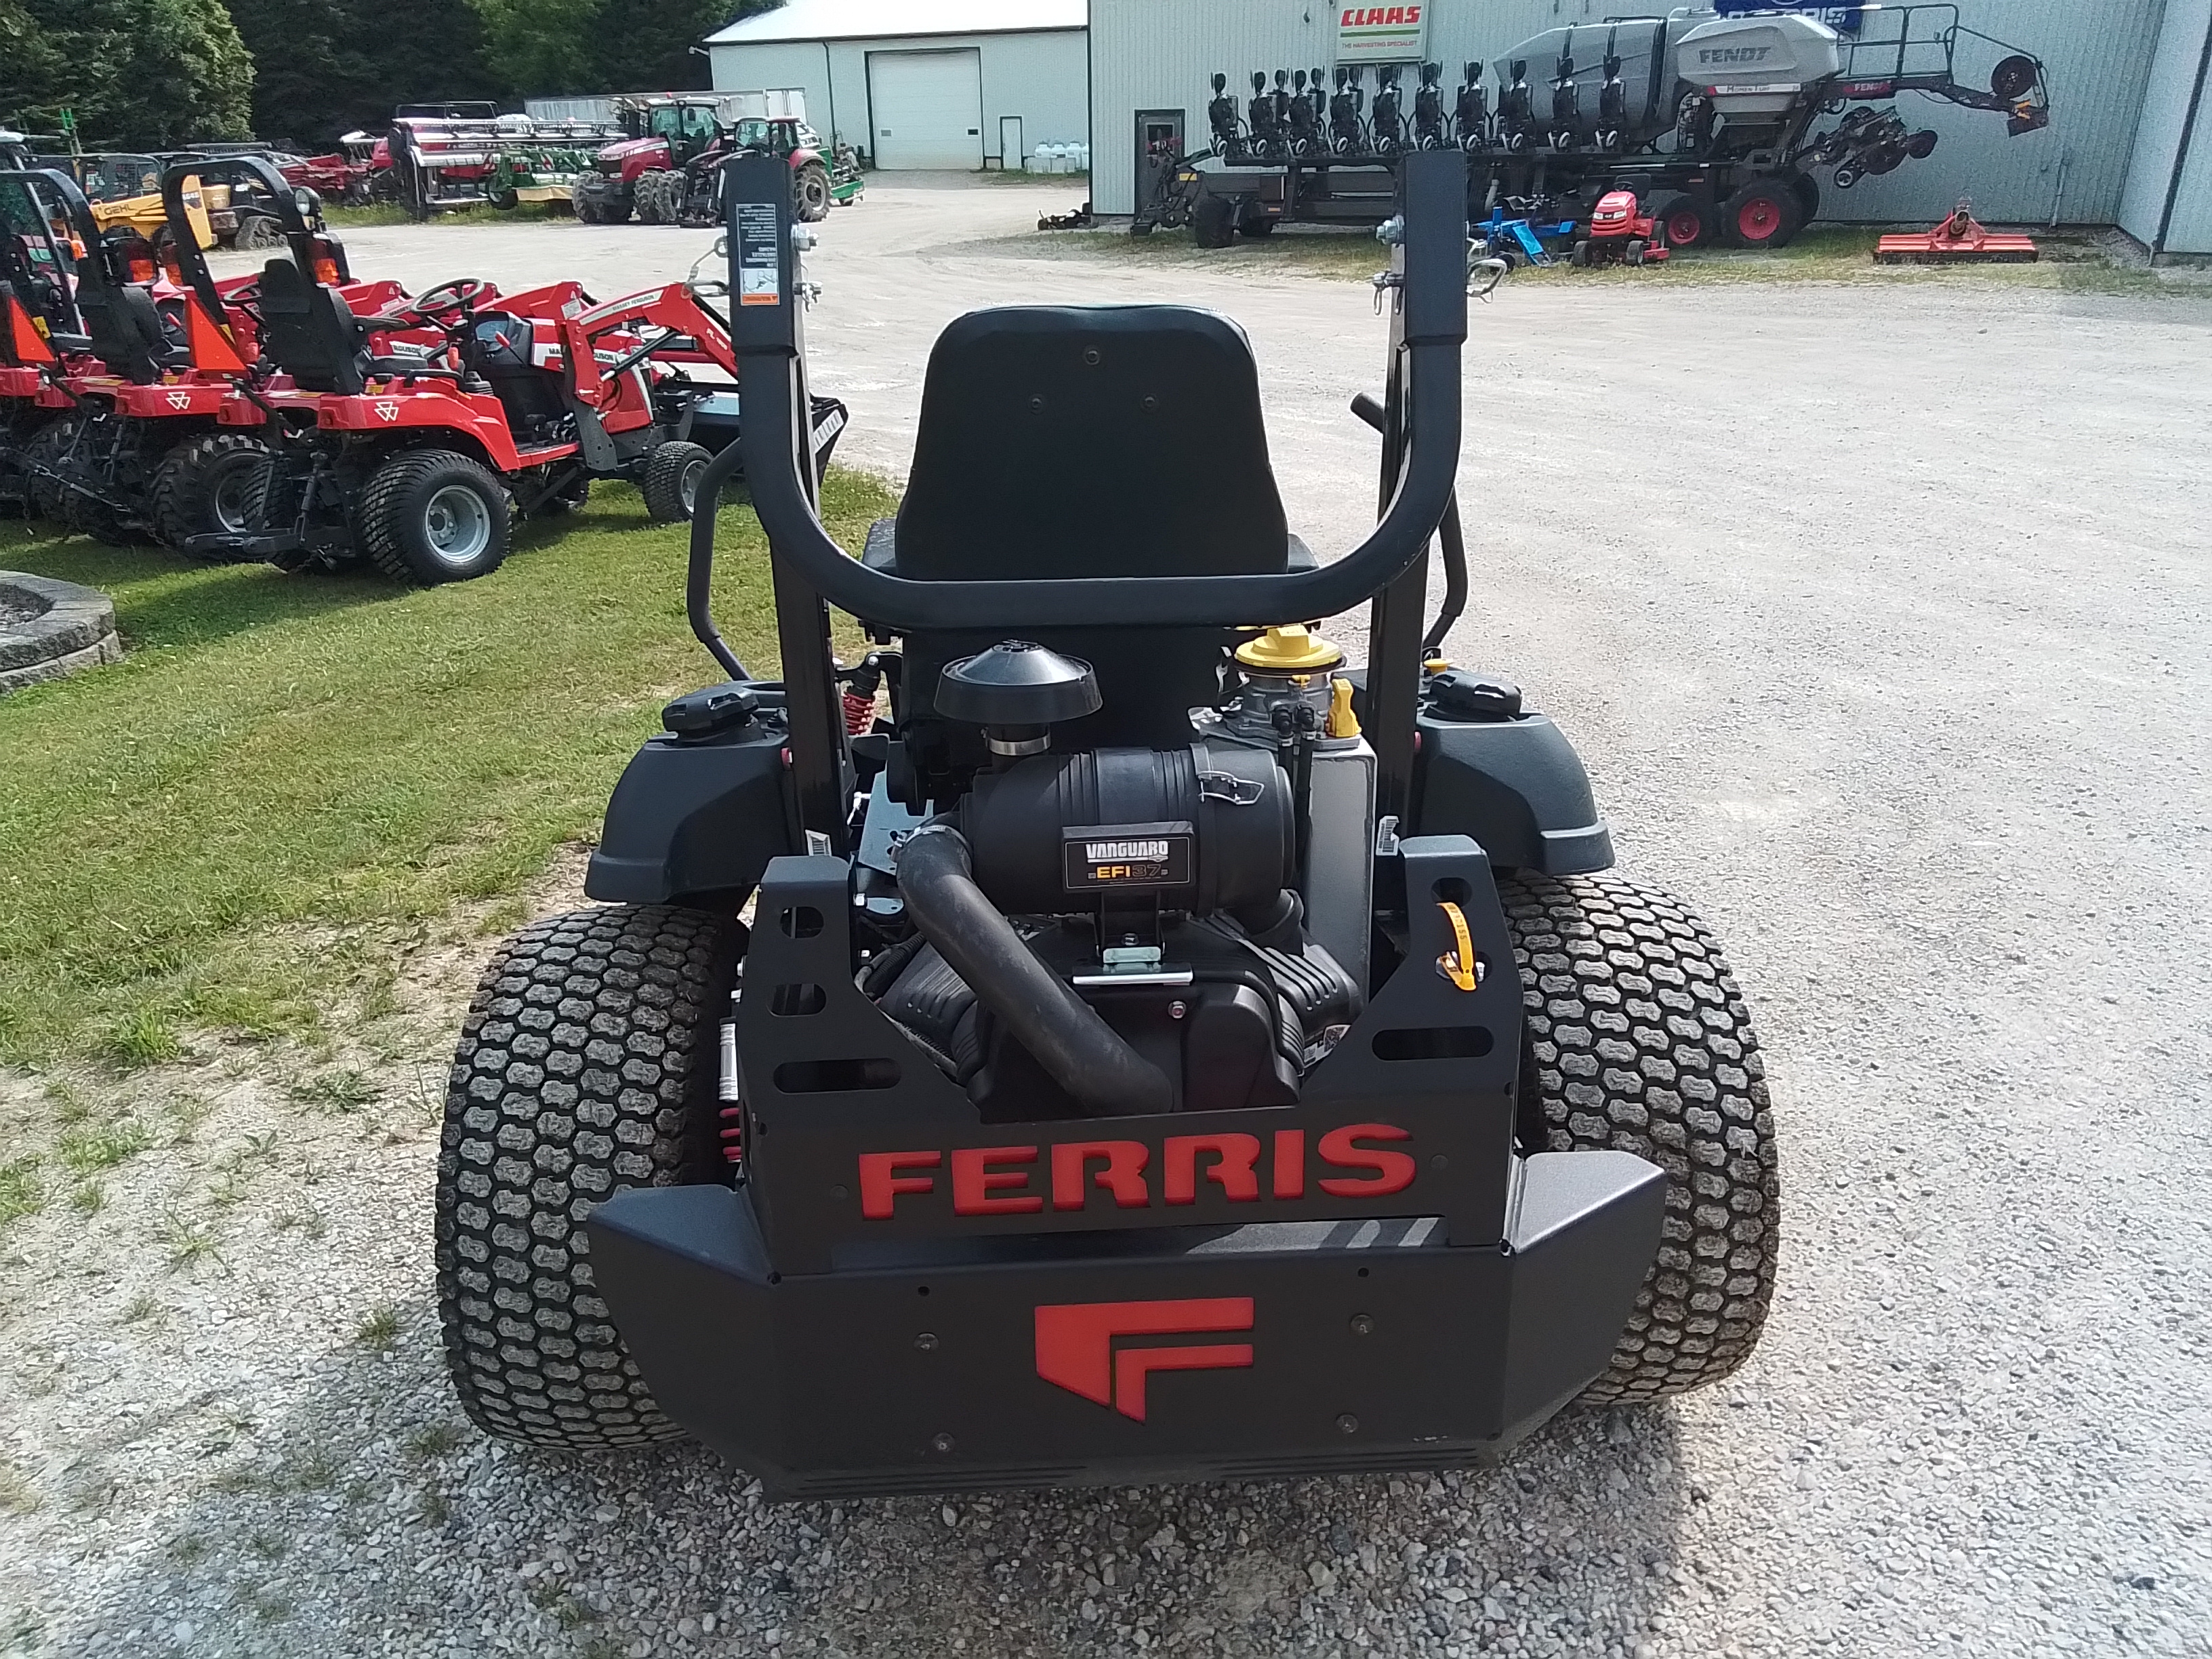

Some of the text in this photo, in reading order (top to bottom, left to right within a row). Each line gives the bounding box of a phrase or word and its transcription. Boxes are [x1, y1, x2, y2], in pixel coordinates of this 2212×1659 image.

[1340, 5, 1422, 26] CLAAS
[1699, 46, 1771, 64] FENDT
[104, 203, 137, 216] GEHL
[1086, 840, 1169, 859] VANGUARD
[858, 1123, 1416, 1219] FERRIS
